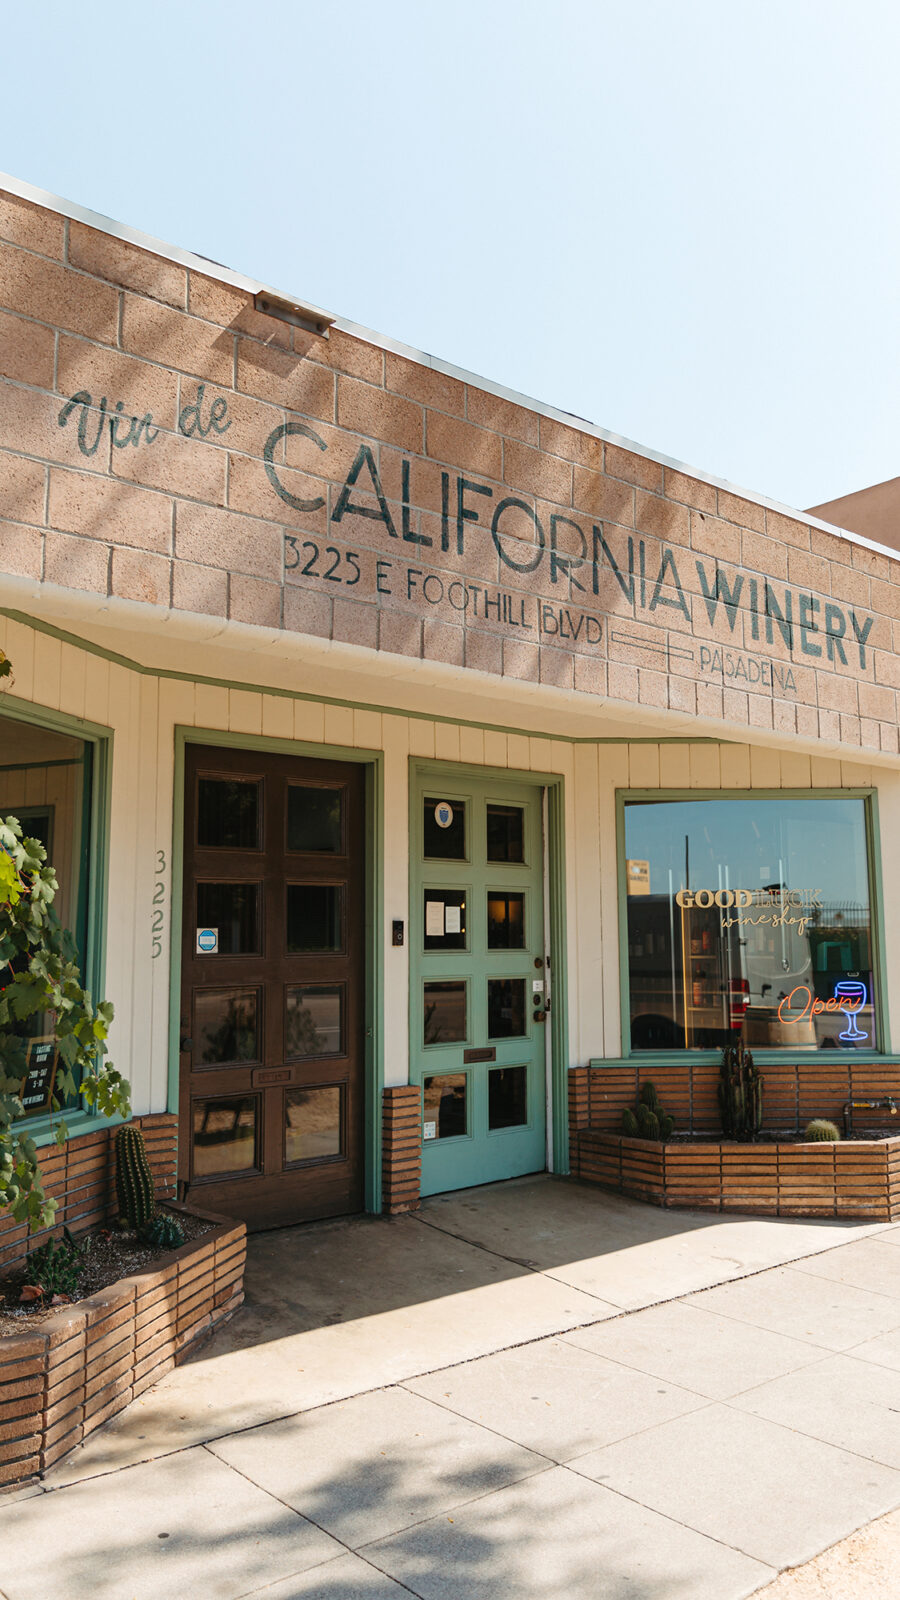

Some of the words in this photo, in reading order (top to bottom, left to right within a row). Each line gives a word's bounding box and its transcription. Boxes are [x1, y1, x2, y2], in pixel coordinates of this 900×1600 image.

[58, 389, 159, 457] Vin
[178, 384, 233, 438] de
[263, 421, 692, 623] CALIFORNIA
[695, 559, 874, 671] WINERY
[284, 535, 361, 586] 3225
[376, 561, 393, 595] E
[407, 568, 533, 630] FOOTHILL
[542, 604, 603, 645] BLVD
[699, 645, 798, 694] PASADENA
[152, 850, 166, 958] 3225
[675, 888, 753, 909] GOOD
[755, 888, 824, 909] LUCK
[777, 985, 861, 1031] Open
